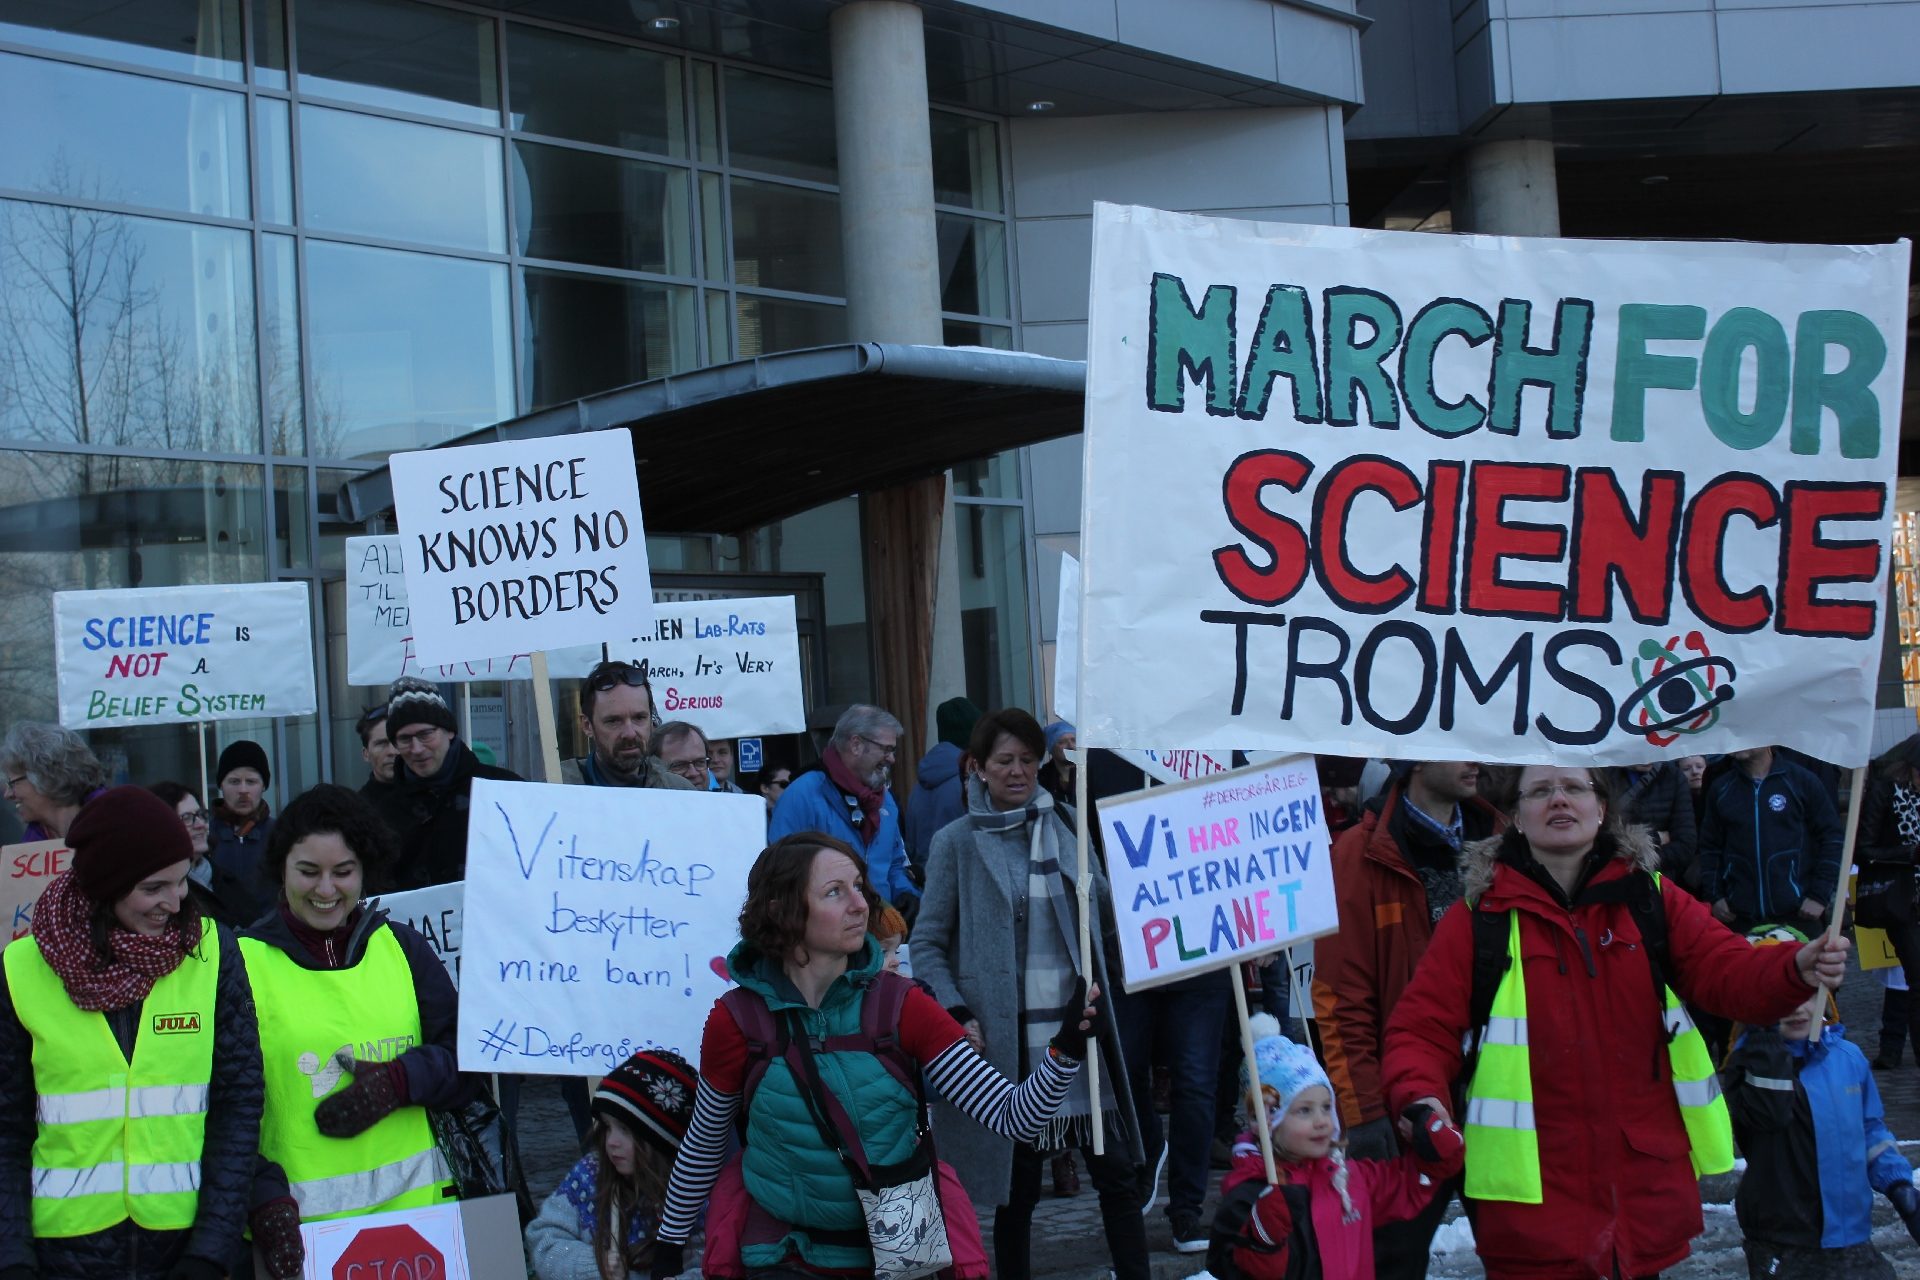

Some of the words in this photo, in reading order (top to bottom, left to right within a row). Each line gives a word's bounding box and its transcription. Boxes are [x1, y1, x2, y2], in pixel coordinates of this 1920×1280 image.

[1147, 272, 1595, 439] MARCH
[1611, 303, 1887, 459] FOR
[438, 457, 589, 514] SCIENCE
[417, 516, 558, 574] KNOWS
[573, 509, 629, 554] NO
[1211, 448, 1887, 640] SCIENCE
[359, 582, 396, 600] TIL
[451, 565, 619, 626] BORDERS
[81, 613, 215, 650] SCIENCE
[235, 626, 251, 642] IS
[104, 652, 169, 678] NOT
[191, 657, 210, 675] A
[664, 687, 723, 711] SERIOUS
[494, 800, 715, 897] Vitenskap
[1187, 816, 1241, 854] HAR
[1249, 794, 1318, 841] INGEN
[1131, 840, 1313, 912] ALTERNATIV
[545, 890, 690, 951] beskytter
[1141, 880, 1304, 970] PLANET
[499, 959, 581, 984] mine
[155, 1016, 200, 1032] JULA
